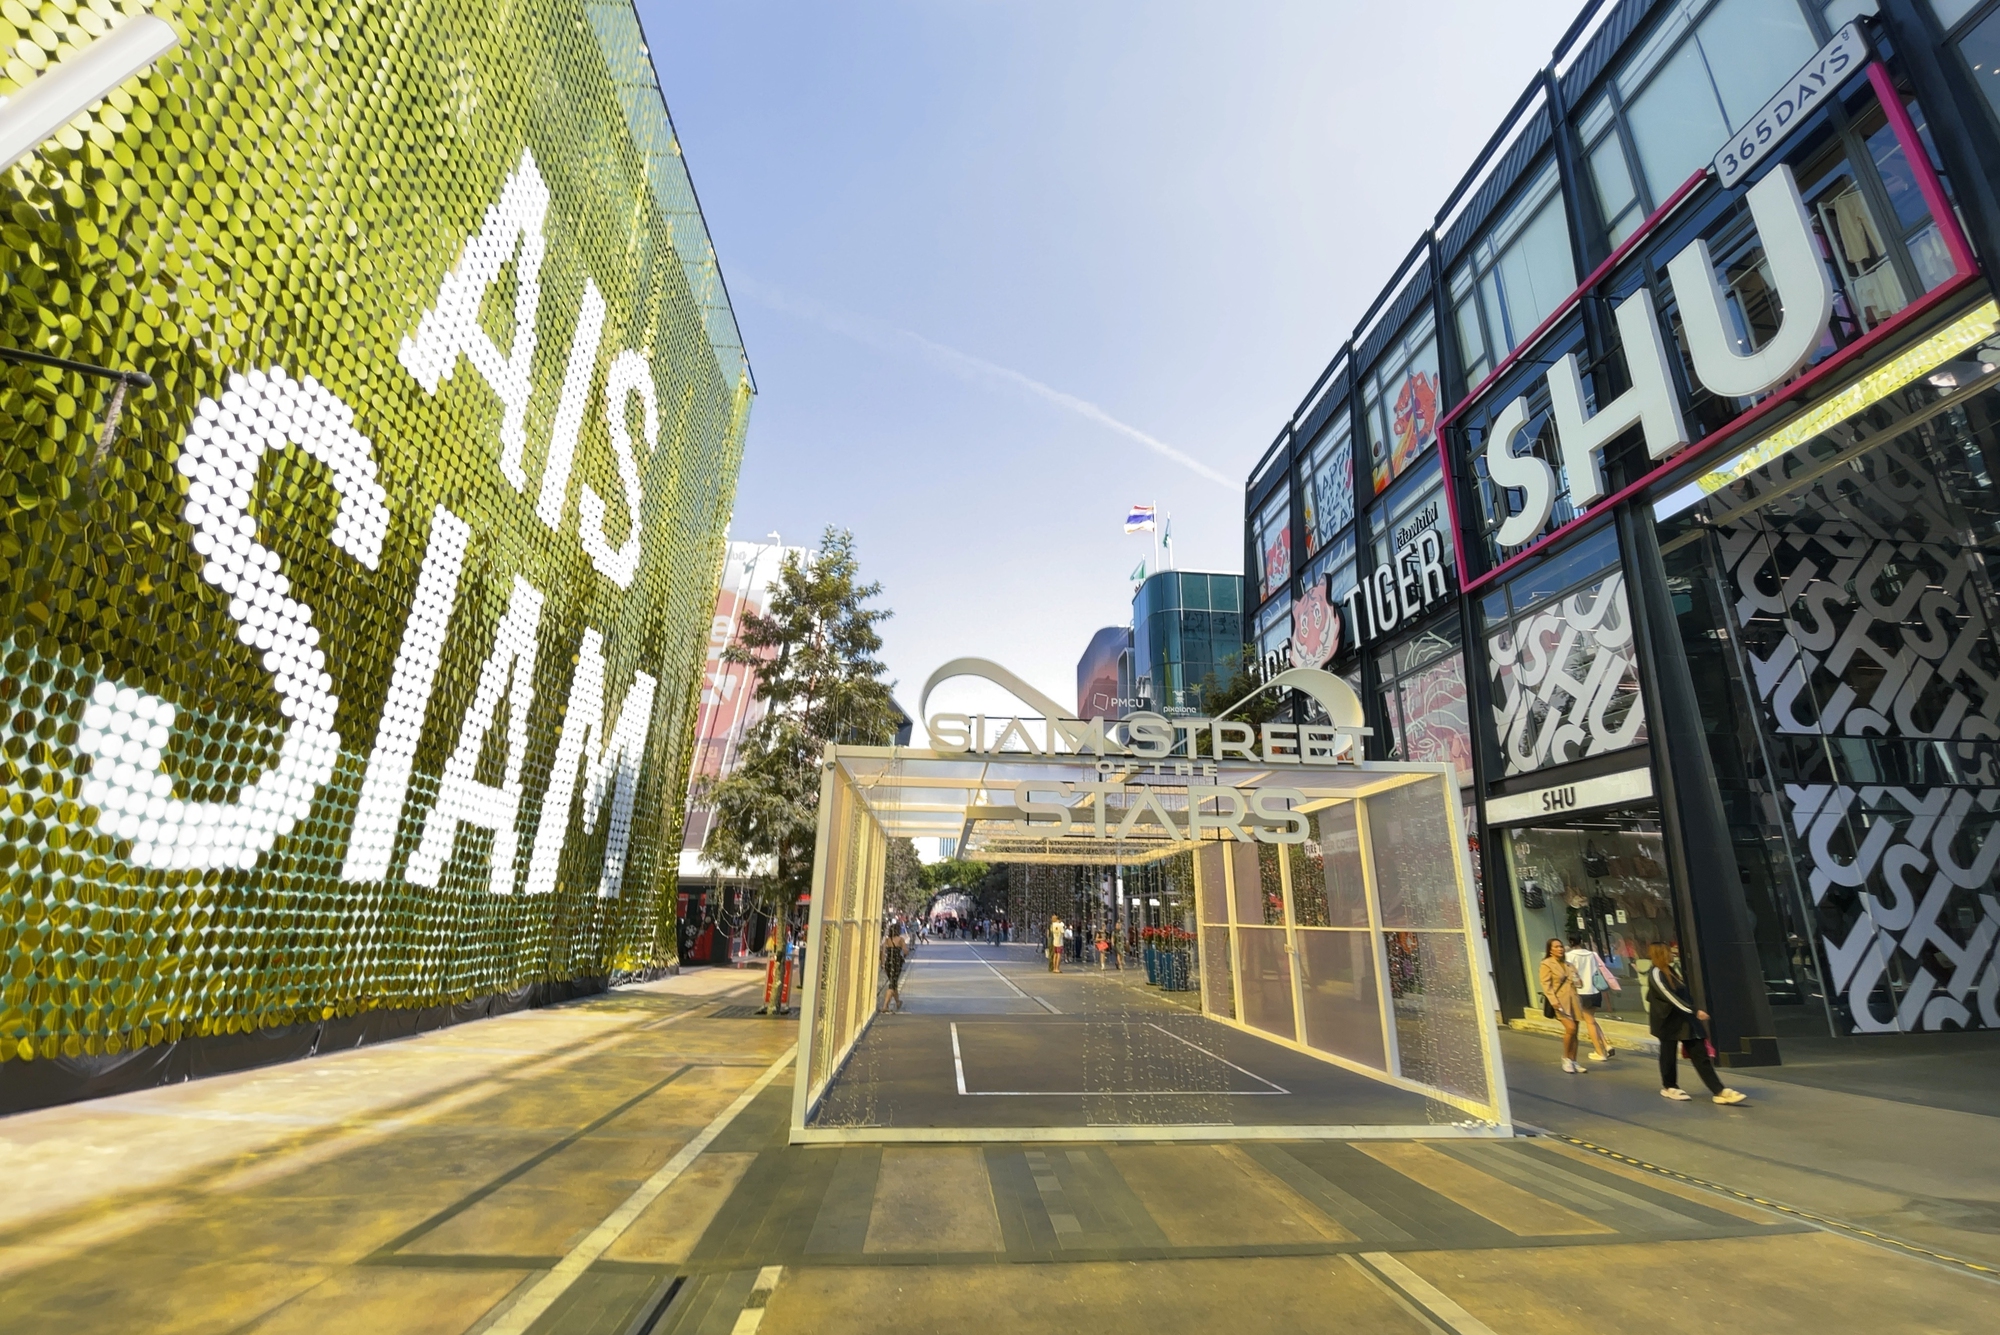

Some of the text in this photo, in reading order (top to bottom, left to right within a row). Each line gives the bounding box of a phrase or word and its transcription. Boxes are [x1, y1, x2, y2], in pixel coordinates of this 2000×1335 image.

[402, 146, 658, 590] AIS
[1487, 163, 1832, 548] SHU
[1343, 528, 1450, 650] TIGER
[78, 366, 657, 899] SIAM
[1111, 698, 1144, 708] PMCU
[929, 713, 1374, 766] SIAM STREET
[1096, 760, 1218, 777] OF THE
[1014, 781, 1311, 844] STARS
[1542, 787, 1577, 811] SHU
